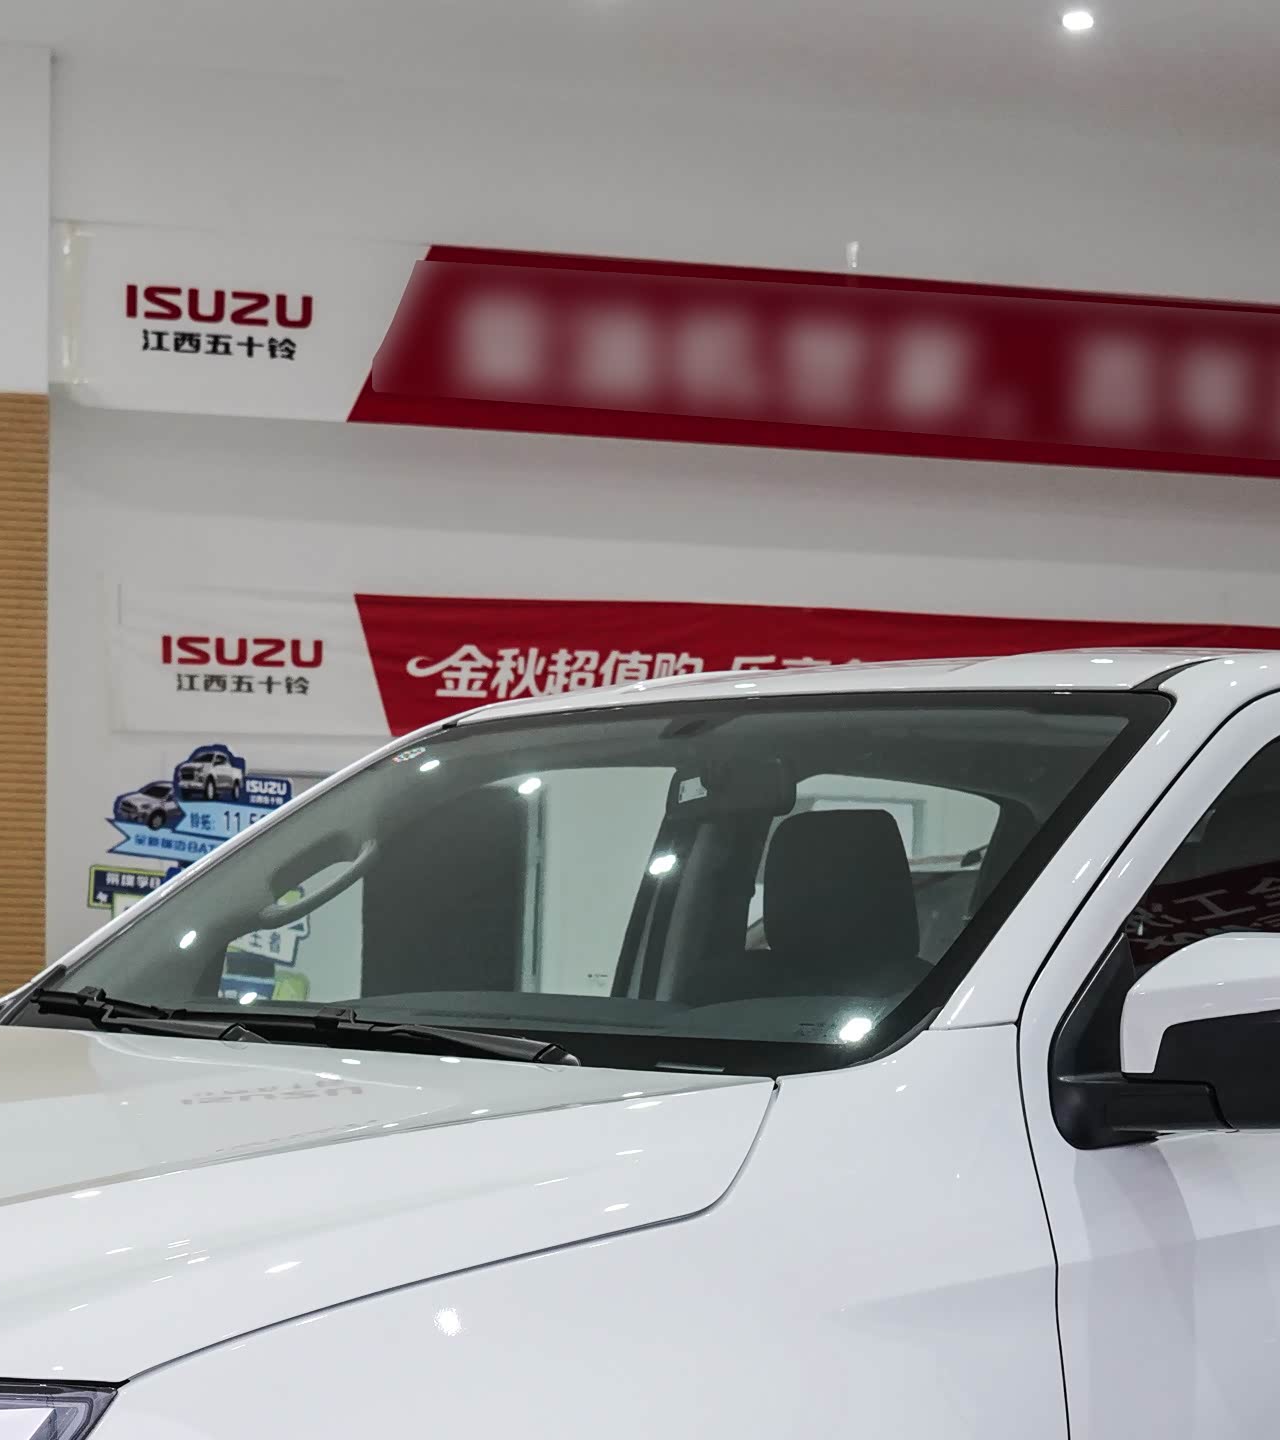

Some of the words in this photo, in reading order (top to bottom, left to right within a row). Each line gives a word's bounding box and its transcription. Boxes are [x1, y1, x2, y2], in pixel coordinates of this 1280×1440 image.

[126, 284, 313, 329] ISUZU
[142, 329, 296, 361] 江西五十铃
[162, 636, 323, 668] ISUZU
[176, 673, 310, 695] 江西五十铃
[245, 780, 288, 796] ISUZU
